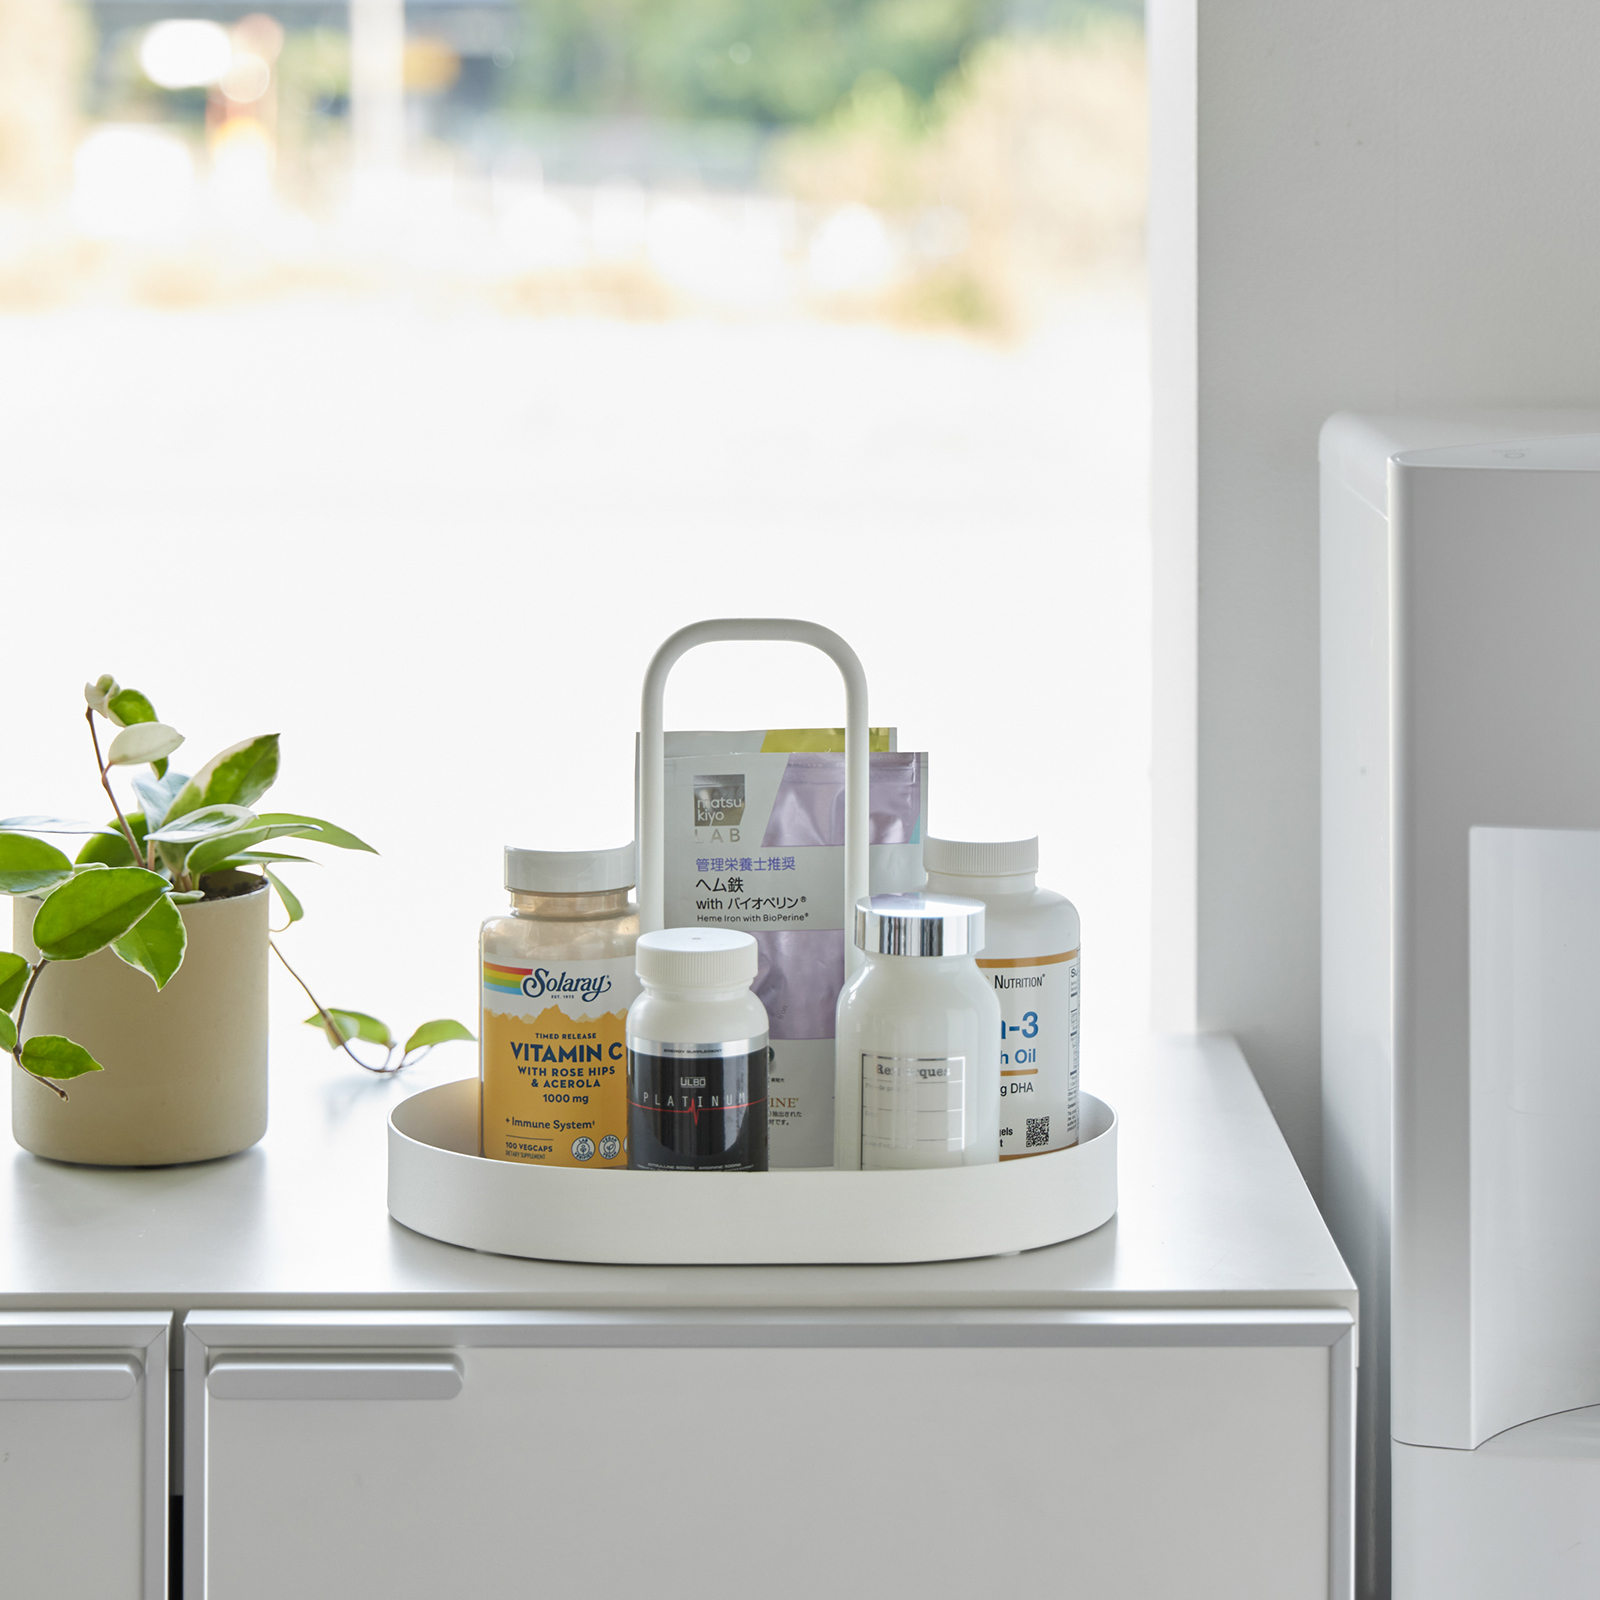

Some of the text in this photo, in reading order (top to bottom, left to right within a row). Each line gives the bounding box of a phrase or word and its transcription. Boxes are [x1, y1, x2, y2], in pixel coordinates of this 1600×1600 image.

[697, 797, 743, 810] matsu
[697, 809, 725, 827] kiyo
[695, 856, 796, 872] 管理栄養士推奨
[695, 876, 744, 894] ヘム鉄
[696, 897, 723, 910] with
[696, 914, 723, 922] Heme
[724, 914, 742, 922] Iron
[742, 914, 761, 922] with
[522, 967, 612, 1003] Solaray
[535, 1032, 597, 1040] TIMED RELEASE
[509, 1041, 623, 1063] VITAMIN C
[1014, 1048, 1036, 1064] Oil
[517, 1065, 616, 1077] WITH ROSE HIPS
[531, 1078, 601, 1089] & ACEROLA
[1010, 1082, 1034, 1094] DHA
[542, 1093, 589, 1105] 1000 mg
[643, 1091, 746, 1108] PLATINUM
[511, 1116, 551, 1129] Immune
[505, 1141, 553, 1153] 100 VEGCAPS
